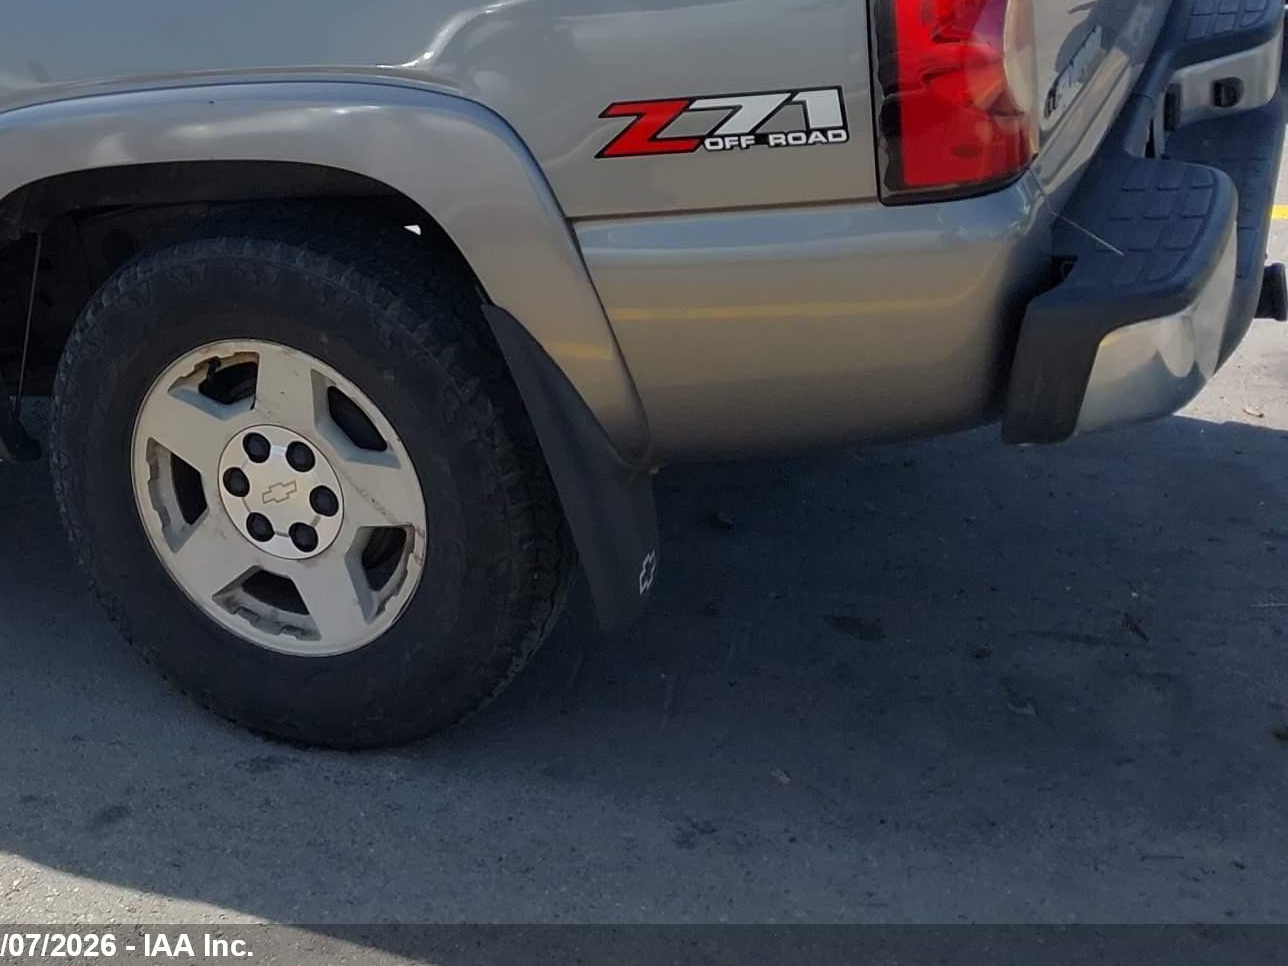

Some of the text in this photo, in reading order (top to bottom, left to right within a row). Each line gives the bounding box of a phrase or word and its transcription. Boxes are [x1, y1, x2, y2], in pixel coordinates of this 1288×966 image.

[596, 86, 846, 157] Z71
[703, 129, 848, 152] OFF ROAD
